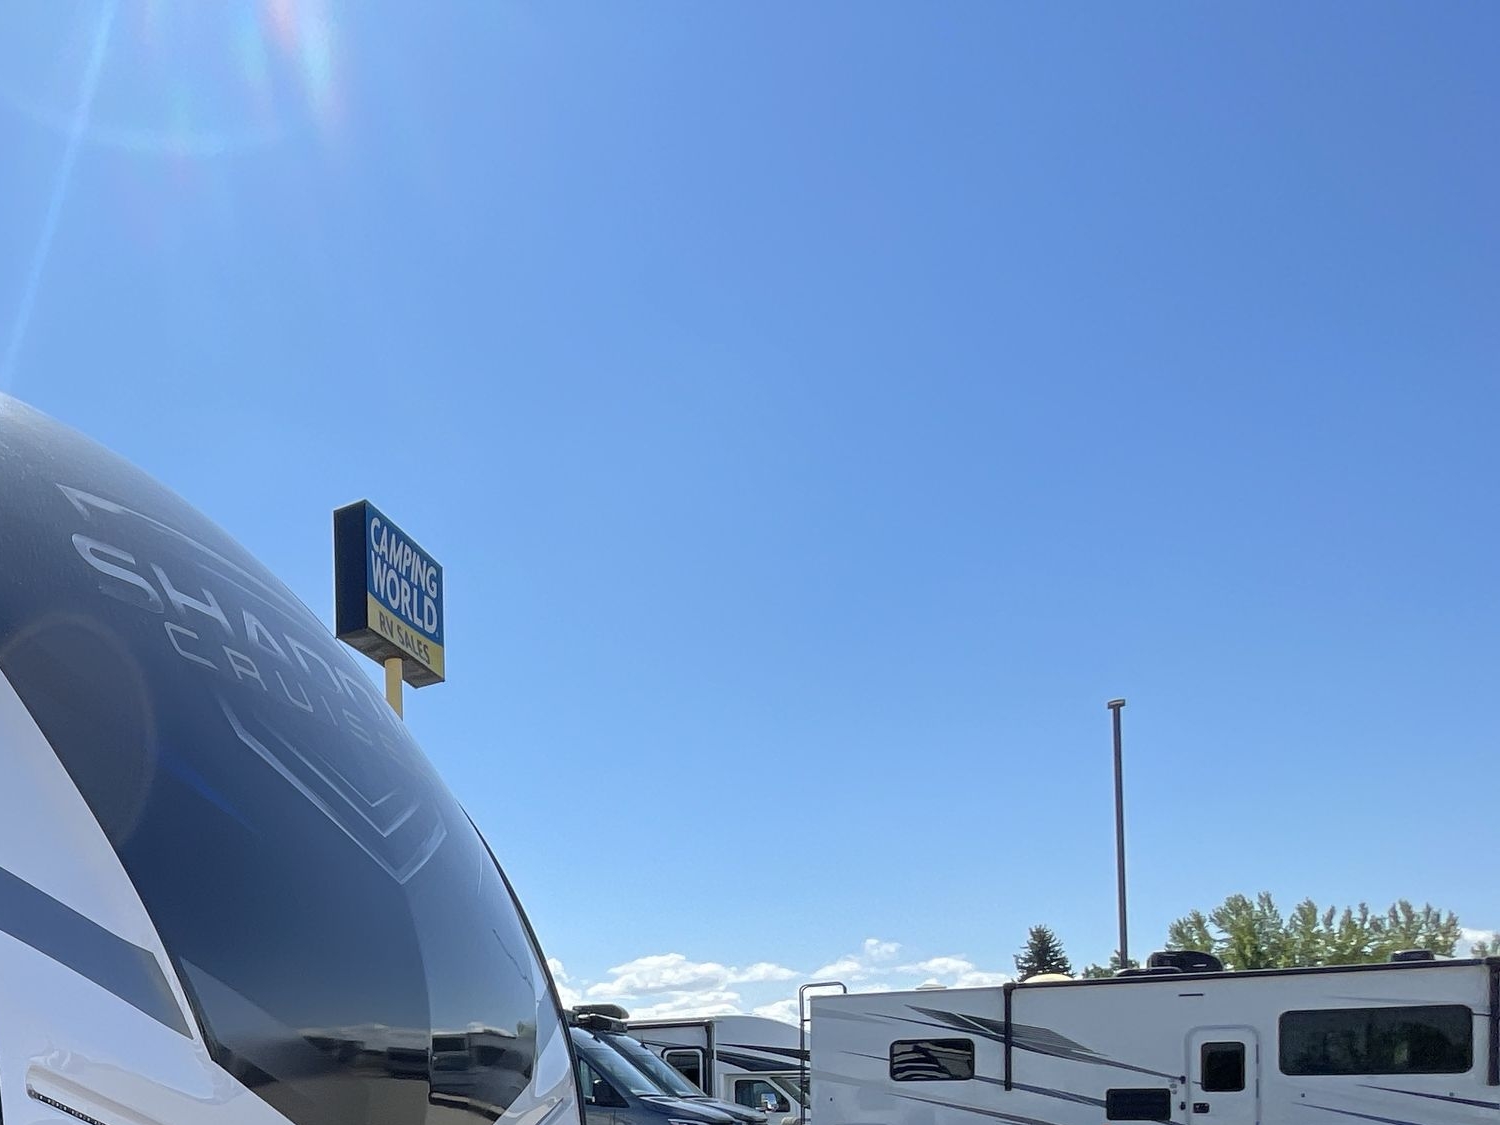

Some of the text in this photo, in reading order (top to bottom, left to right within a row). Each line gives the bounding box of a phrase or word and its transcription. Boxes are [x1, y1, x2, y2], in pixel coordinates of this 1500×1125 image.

[370, 516, 437, 599] CAMPING
[371, 550, 438, 634] WORLD
[378, 610, 431, 665] RV SALES
[164, 620, 405, 766] CRUISE
